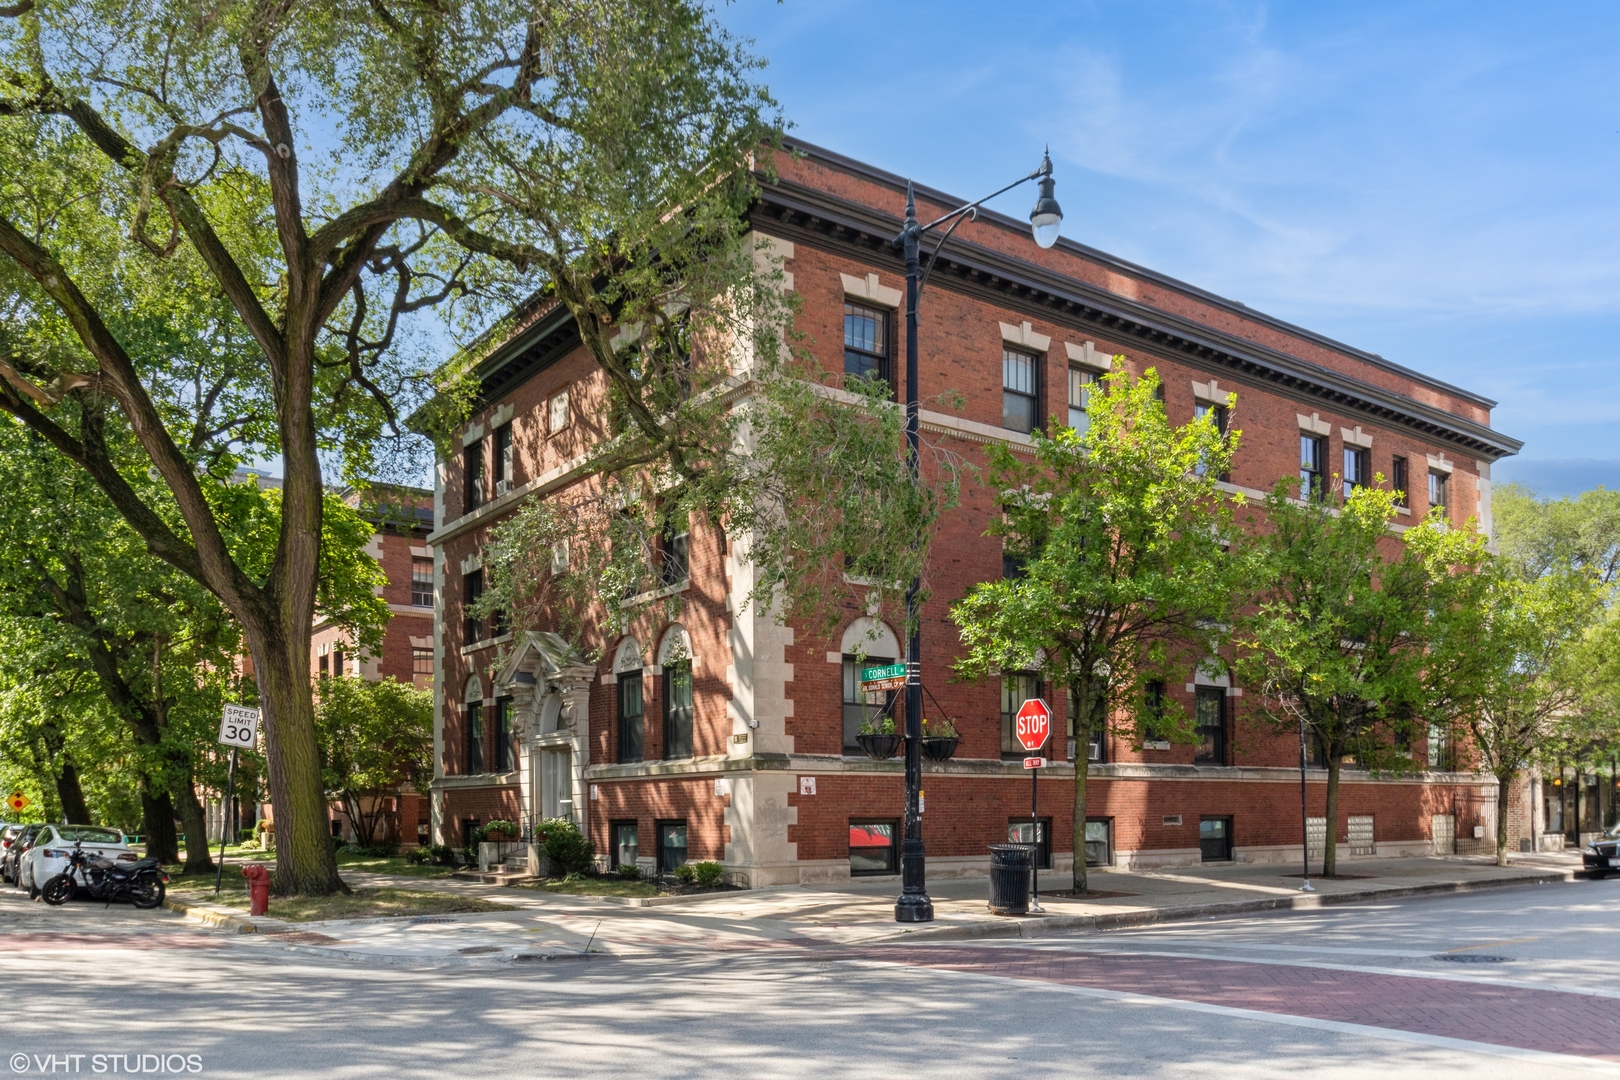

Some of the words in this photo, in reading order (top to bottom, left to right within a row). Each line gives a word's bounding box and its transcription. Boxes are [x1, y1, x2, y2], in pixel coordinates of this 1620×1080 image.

[868, 667, 898, 679] CORNELL
[227, 708, 256, 718] SPEED
[229, 717, 252, 726] LIMIT
[1019, 715, 1046, 734] STOP
[225, 726, 251, 742] 30
